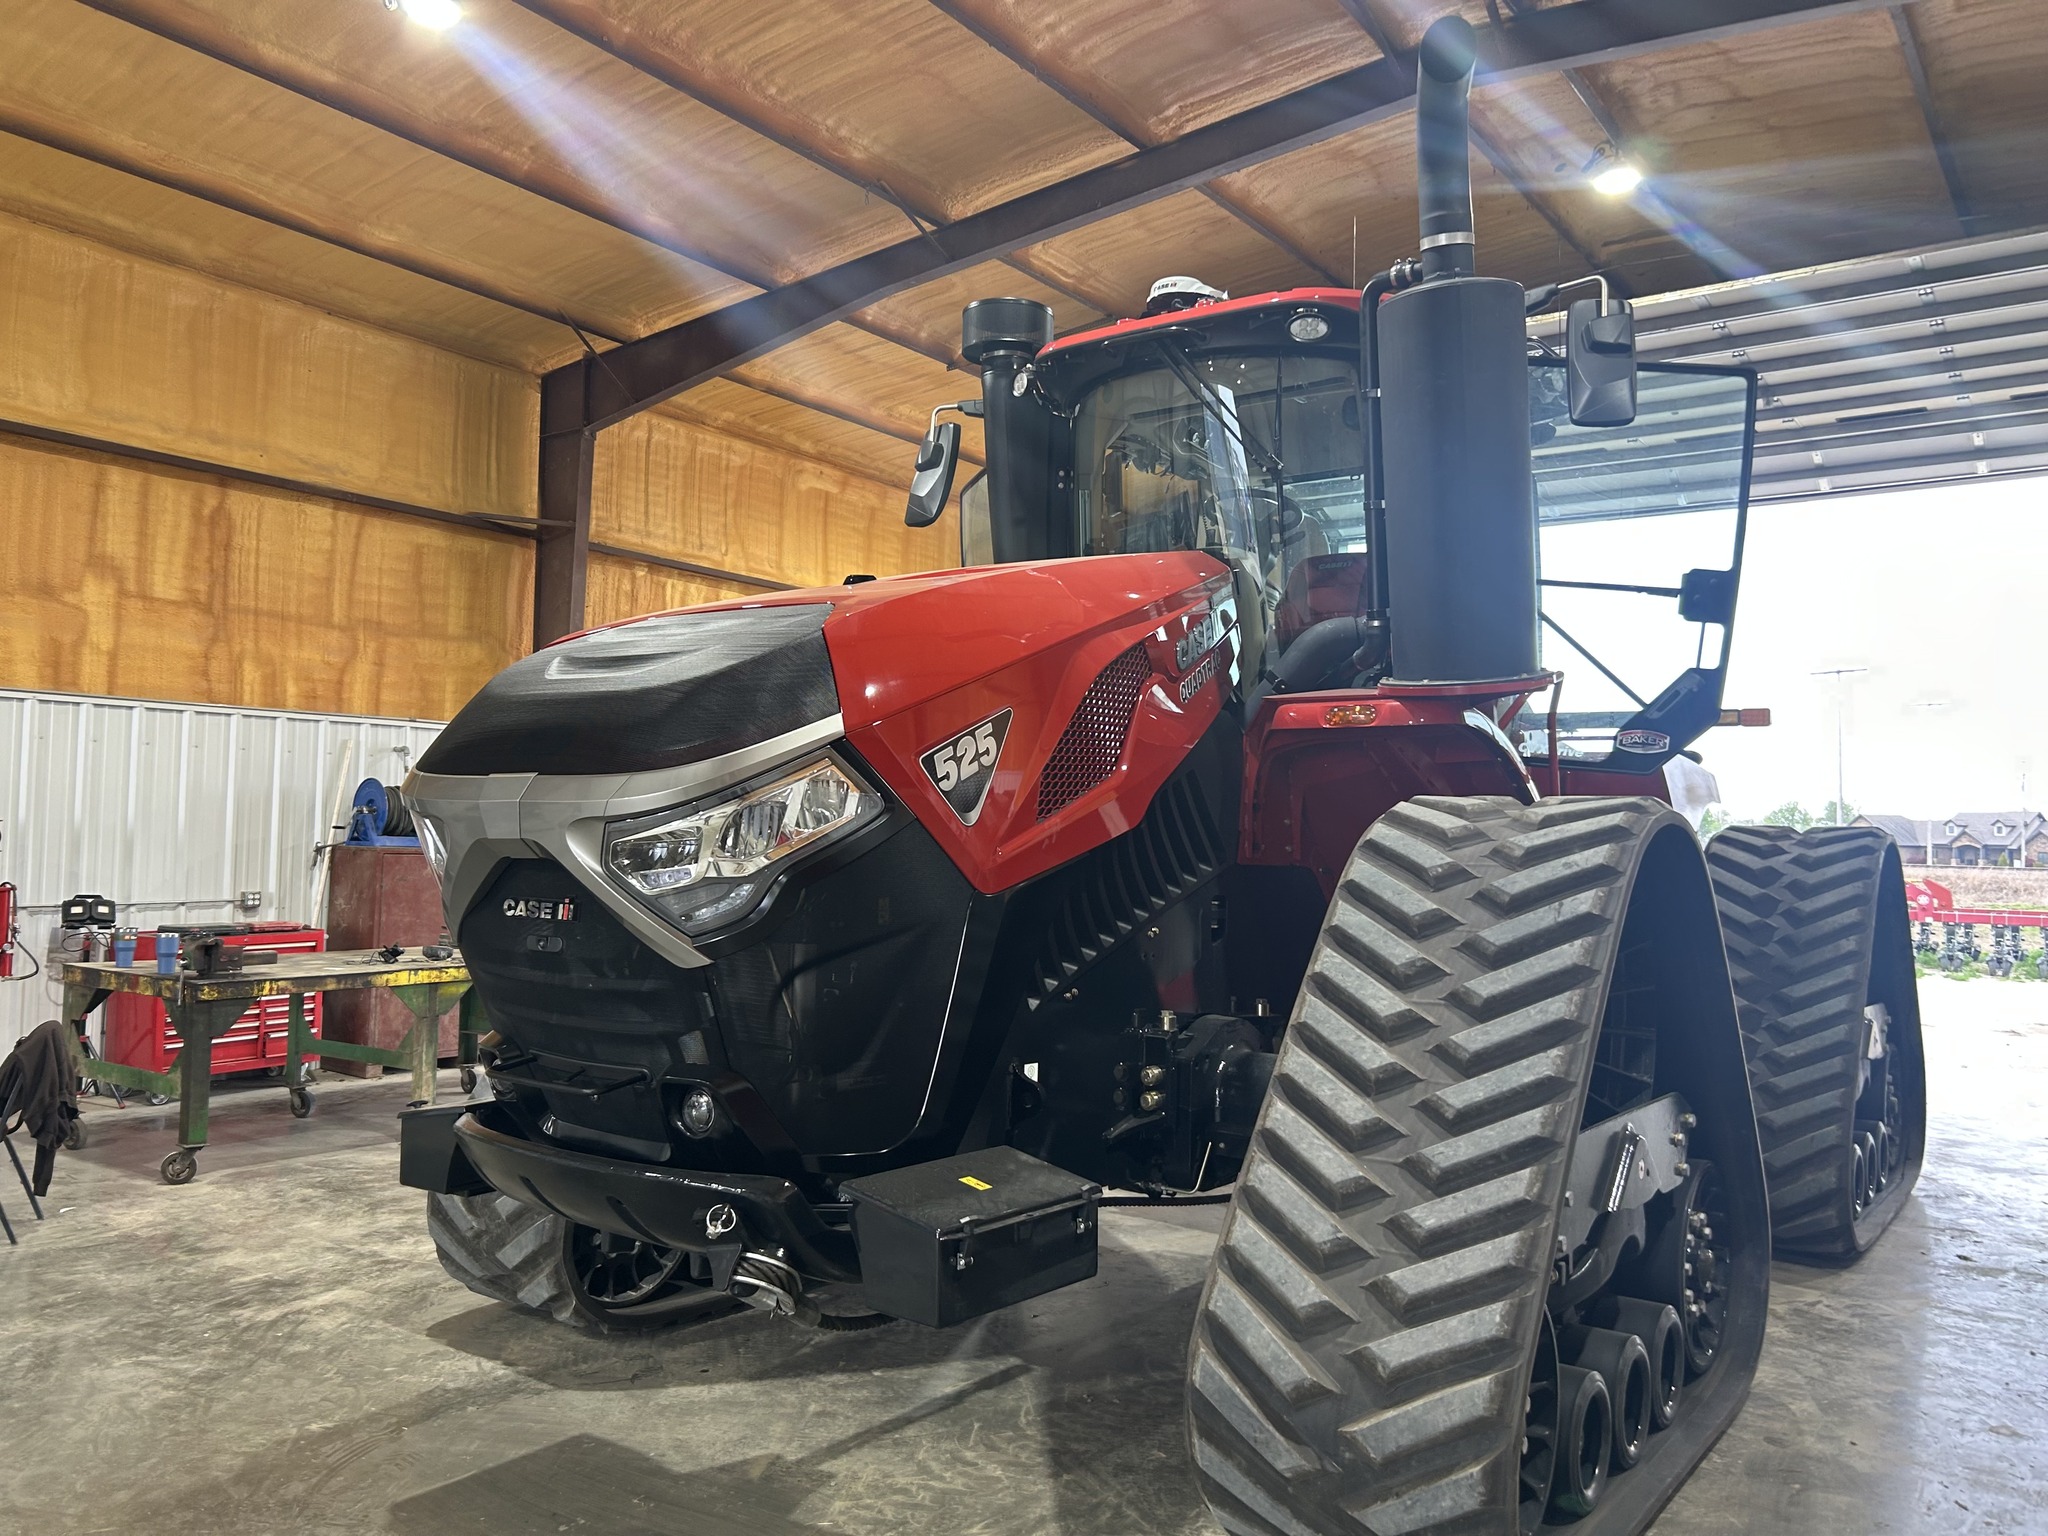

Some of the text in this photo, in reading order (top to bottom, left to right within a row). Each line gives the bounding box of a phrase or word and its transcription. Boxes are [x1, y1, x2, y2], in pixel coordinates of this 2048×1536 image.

[1176, 614, 1212, 670] CASE
[934, 722, 997, 791] 525
[1622, 734, 1664, 746] BAKER
[503, 898, 553, 918] CASE
